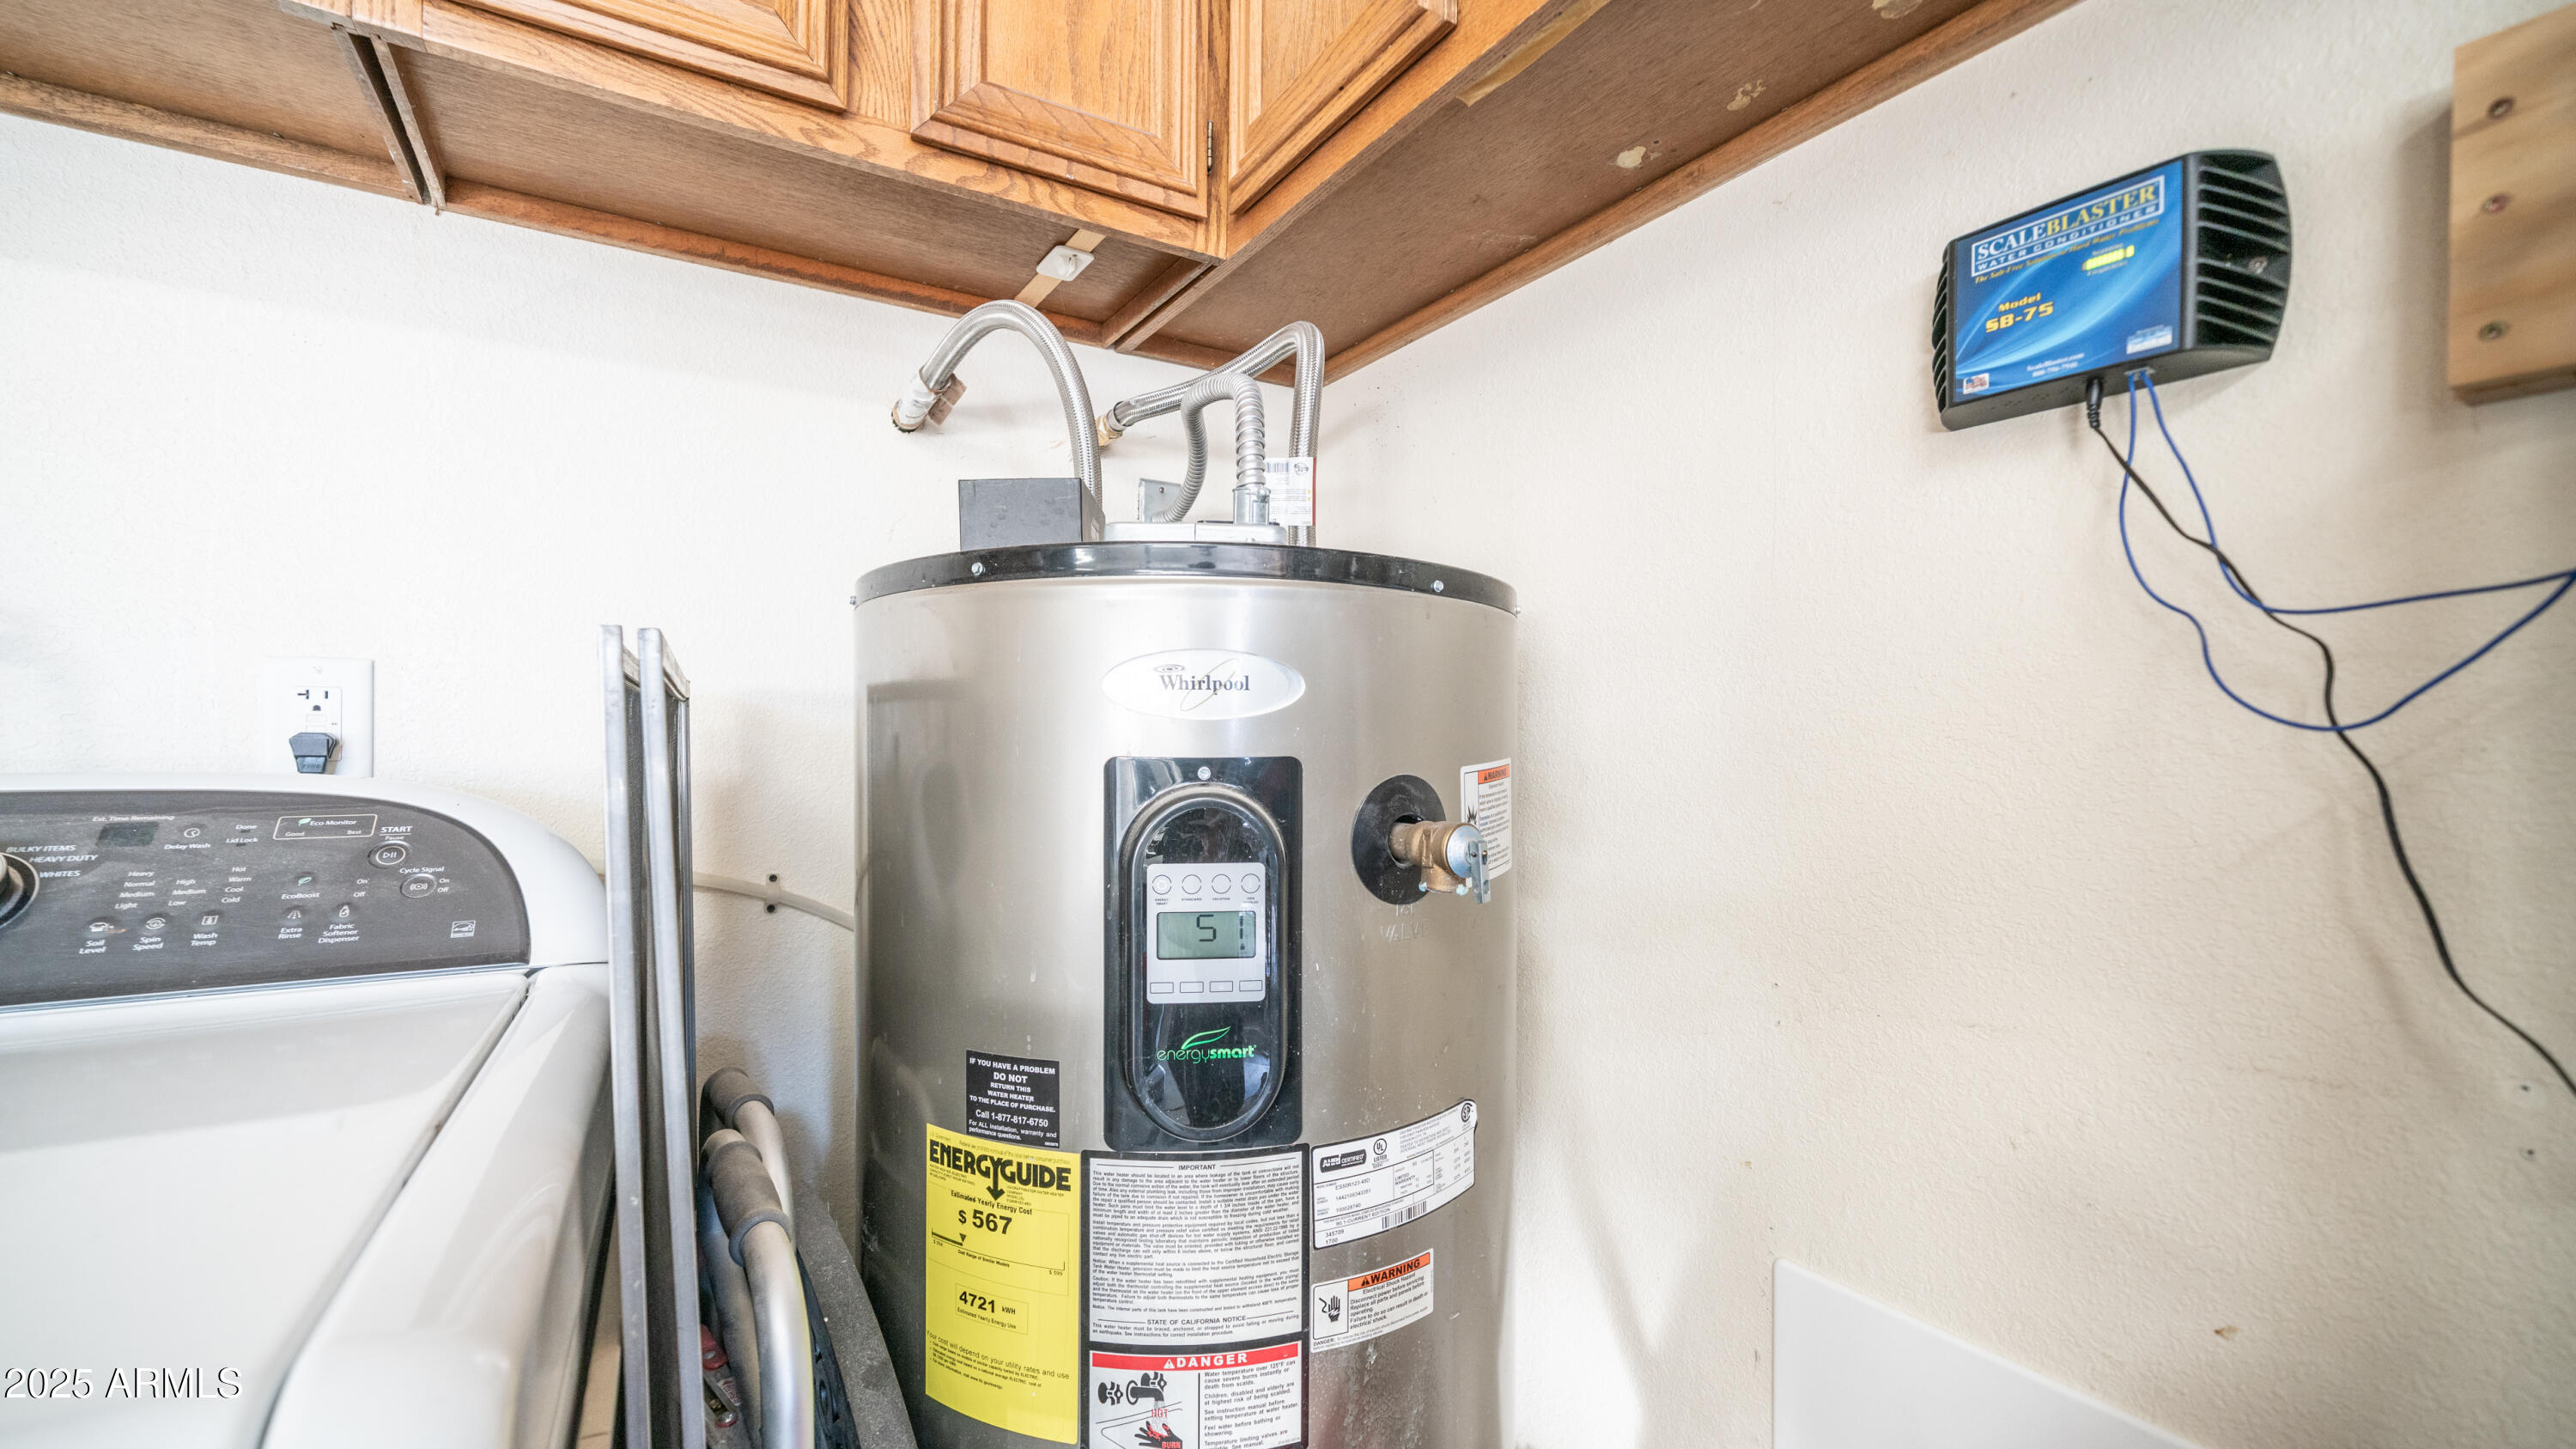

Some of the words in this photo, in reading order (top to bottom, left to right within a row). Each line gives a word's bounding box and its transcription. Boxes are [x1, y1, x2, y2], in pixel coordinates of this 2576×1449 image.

[1978, 186, 2157, 260] SCALEBLASTER
[1978, 251, 2026, 271] WATER
[2033, 205, 2157, 252] CONDITIONER
[1998, 293, 2041, 312] Model
[1986, 301, 2054, 332] SB-75
[1159, 675, 1249, 695] Whirlpool
[132, 942, 164, 951] Speed
[993, 1062, 1011, 1070] HAVE
[1020, 1065, 1055, 1075] PROBLEM
[993, 1072, 1005, 1081] DO
[1009, 1075, 1028, 1083] NOT
[987, 1090, 1008, 1099] WATER
[1020, 1104, 1055, 1112] PURCHASE.
[975, 1110, 989, 1118] Call
[991, 1112, 1048, 1127] 1-877-817-6750
[969, 1127, 996, 1136] performance
[990, 1123, 1018, 1133] installation,
[1021, 1129, 1044, 1137] warranty
[929, 1139, 1072, 1192] ENERGYGUIDE
[1341, 1154, 1364, 1164] CERTIFIED
[1374, 1154, 1387, 1164] LISTED
[1394, 1172, 1410, 1181] LIMITED
[1394, 1175, 1415, 1185] WARRANTY
[951, 1190, 976, 1202] Estimated
[977, 1198, 995, 1209] Yearly
[996, 1202, 1017, 1215] Energy
[958, 1209, 967, 1225] $
[972, 1209, 1012, 1235] 567
[1370, 1259, 1420, 1282] WARNING
[1350, 1294, 1376, 1305] Disconnect
[1378, 1289, 1391, 1298] power
[1393, 1284, 1406, 1293] before
[1406, 1275, 1425, 1288] servicing
[1363, 1284, 1385, 1294] Electrical
[1387, 1278, 1400, 1288] Shock
[1400, 1273, 1415, 1282] Hazard
[959, 1291, 995, 1313] 4721
[1001, 1306, 1016, 1315] kWH
[957, 1307, 976, 1318] Estimated
[977, 1313, 991, 1323] Yearly
[991, 1318, 1006, 1328] Energy
[927, 1330, 937, 1341] Your
[938, 1336, 948, 1345] cost
[959, 1346, 980, 1359] depend
[990, 1355, 1004, 1366] your
[1005, 1360, 1022, 1371] utility
[1024, 1365, 1040, 1374] rates
[1177, 1353, 1248, 1368] DANGER
[1231, 1388, 1254, 1397] disabled
[1151, 1409, 1168, 1417] HOT
